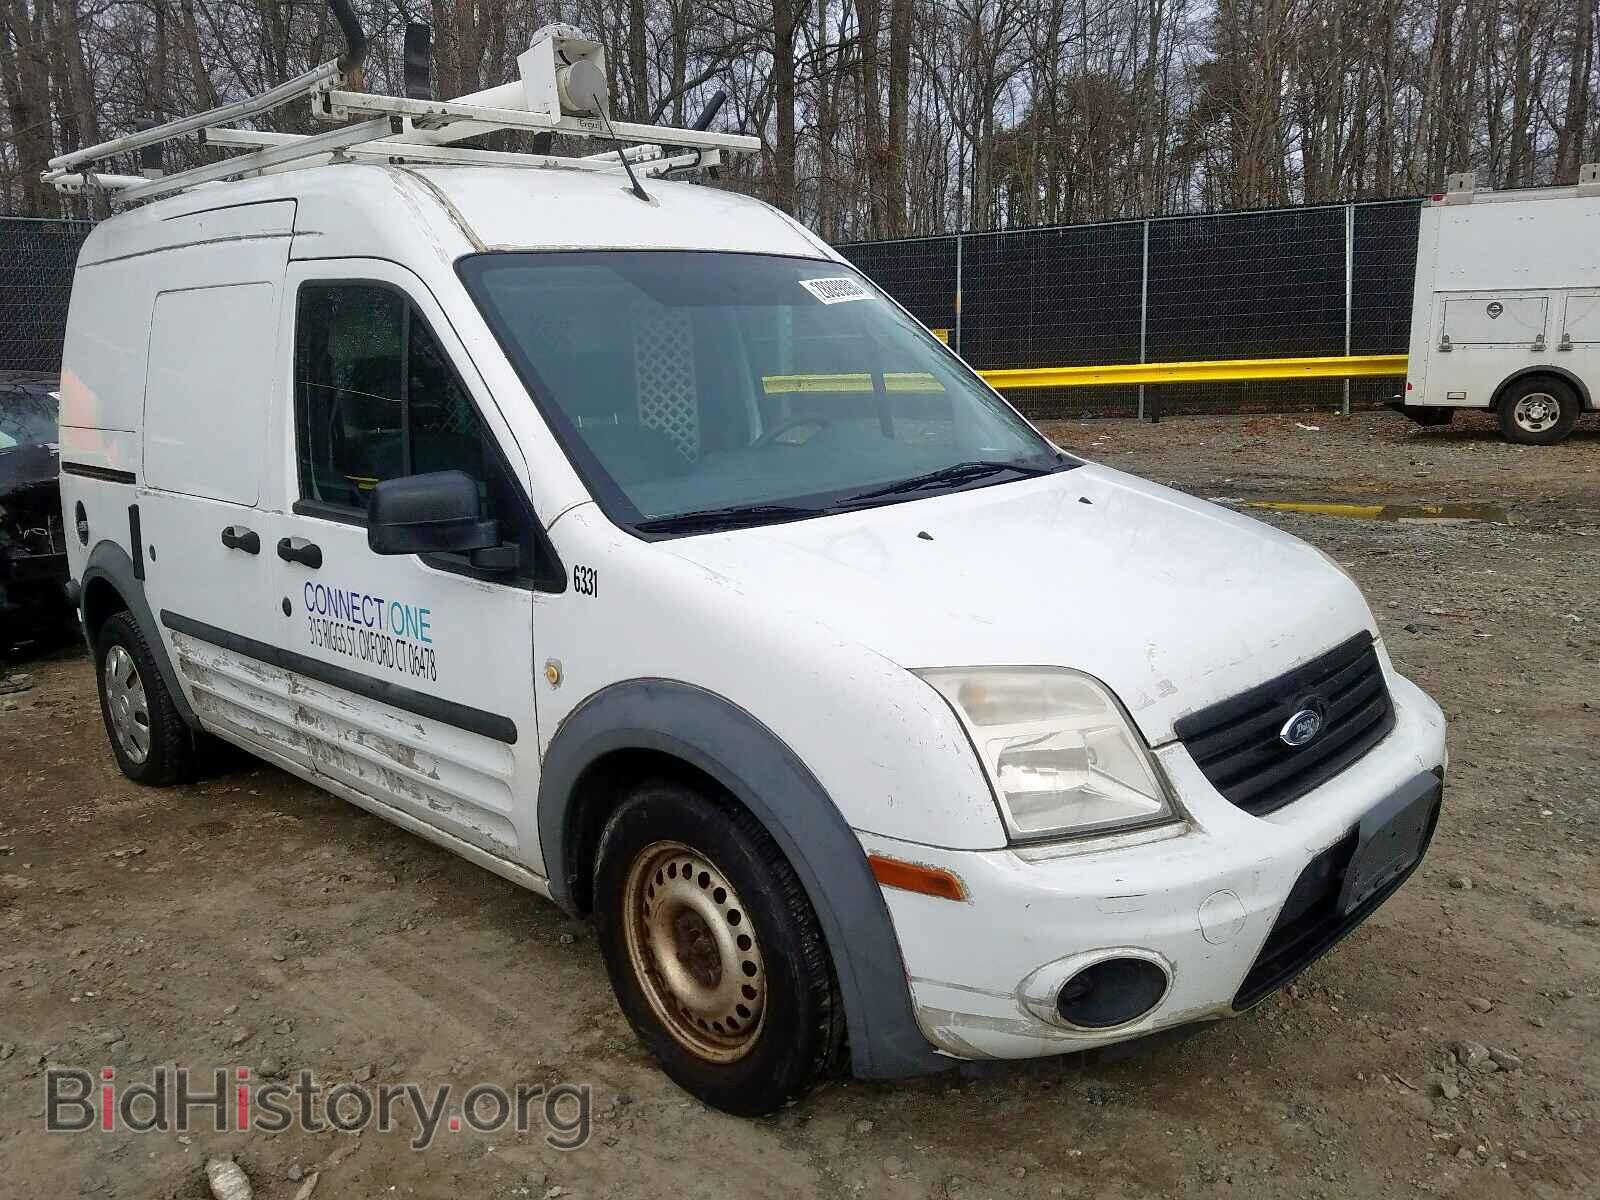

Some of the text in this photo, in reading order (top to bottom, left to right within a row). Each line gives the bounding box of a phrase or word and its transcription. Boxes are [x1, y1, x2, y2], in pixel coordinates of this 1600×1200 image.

[573, 564, 598, 598] 6331
[308, 616, 323, 648] 315
[358, 628, 394, 669] OXFORD
[395, 638, 408, 672] CT
[408, 643, 437, 682] 06478
